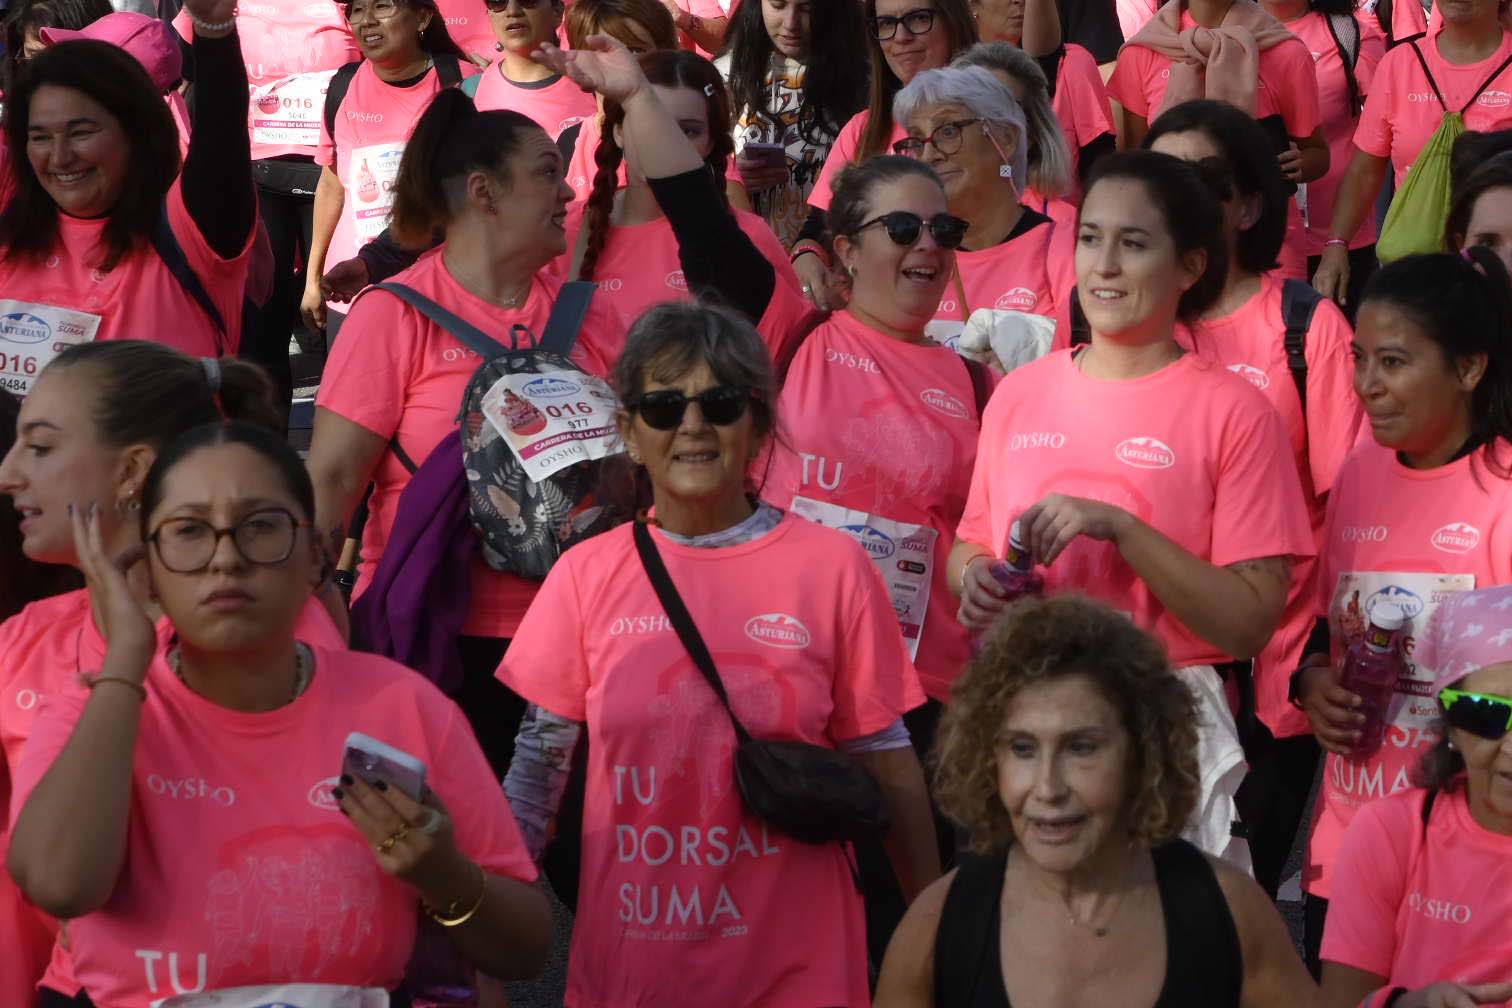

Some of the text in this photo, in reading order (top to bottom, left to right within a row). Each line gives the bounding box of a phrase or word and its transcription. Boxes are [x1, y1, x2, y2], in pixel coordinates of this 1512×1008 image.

[282, 97, 313, 109] 016
[346, 111, 383, 123] OYSHO
[57, 325, 85, 337] SUMA
[546, 402, 593, 418] 016
[534, 433, 573, 451] CARRERA
[1010, 432, 1065, 452] OYSHO
[539, 445, 583, 468] OYSHO
[799, 453, 844, 490] TU
[614, 765, 657, 805] TU
[1333, 754, 1410, 797] SUMA
[616, 824, 781, 867] DORSAL
[619, 882, 742, 926] SUMA
[135, 947, 207, 994] TU
